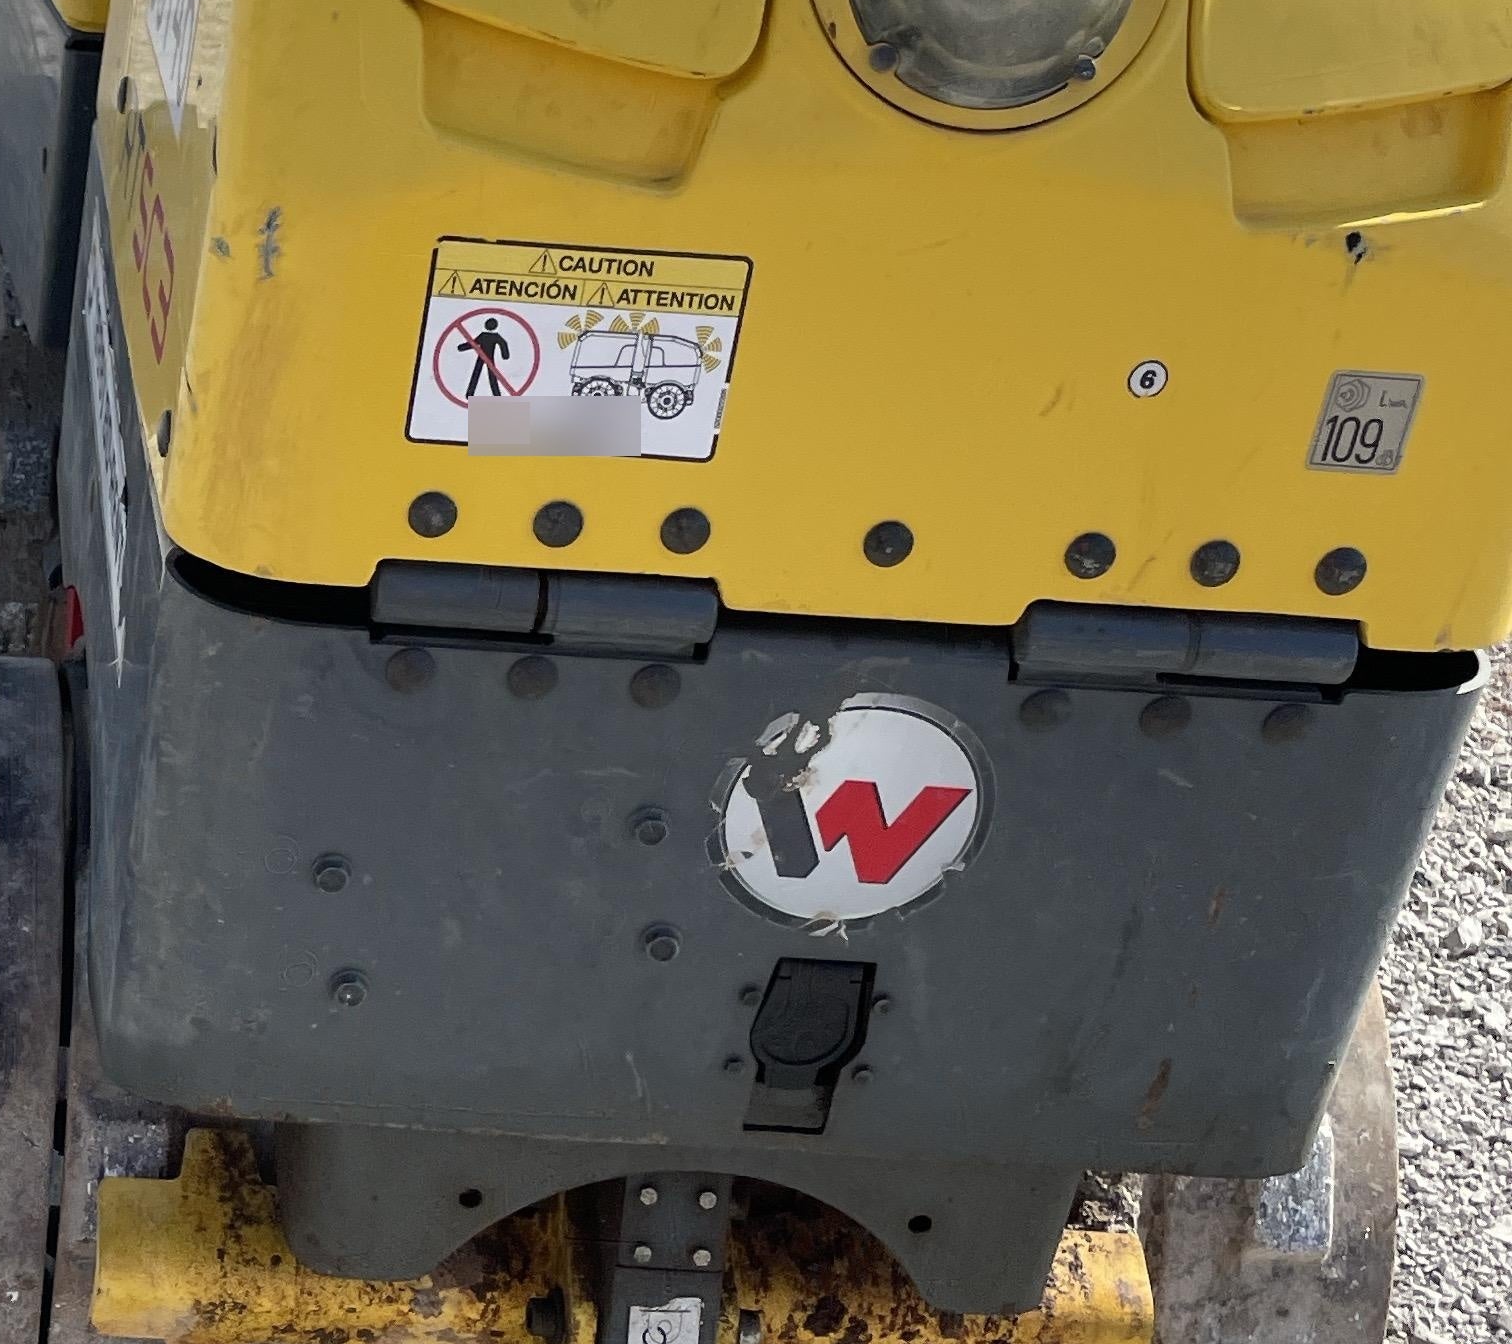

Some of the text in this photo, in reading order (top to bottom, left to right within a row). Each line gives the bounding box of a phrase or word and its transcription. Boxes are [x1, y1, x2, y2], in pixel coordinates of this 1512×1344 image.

[557, 255, 655, 277] CAUTION
[468, 277, 578, 301] ATENCIÓN
[616, 291, 736, 312] ATTENTION
[1139, 369, 1157, 390] 6
[1320, 414, 1384, 465] 109
